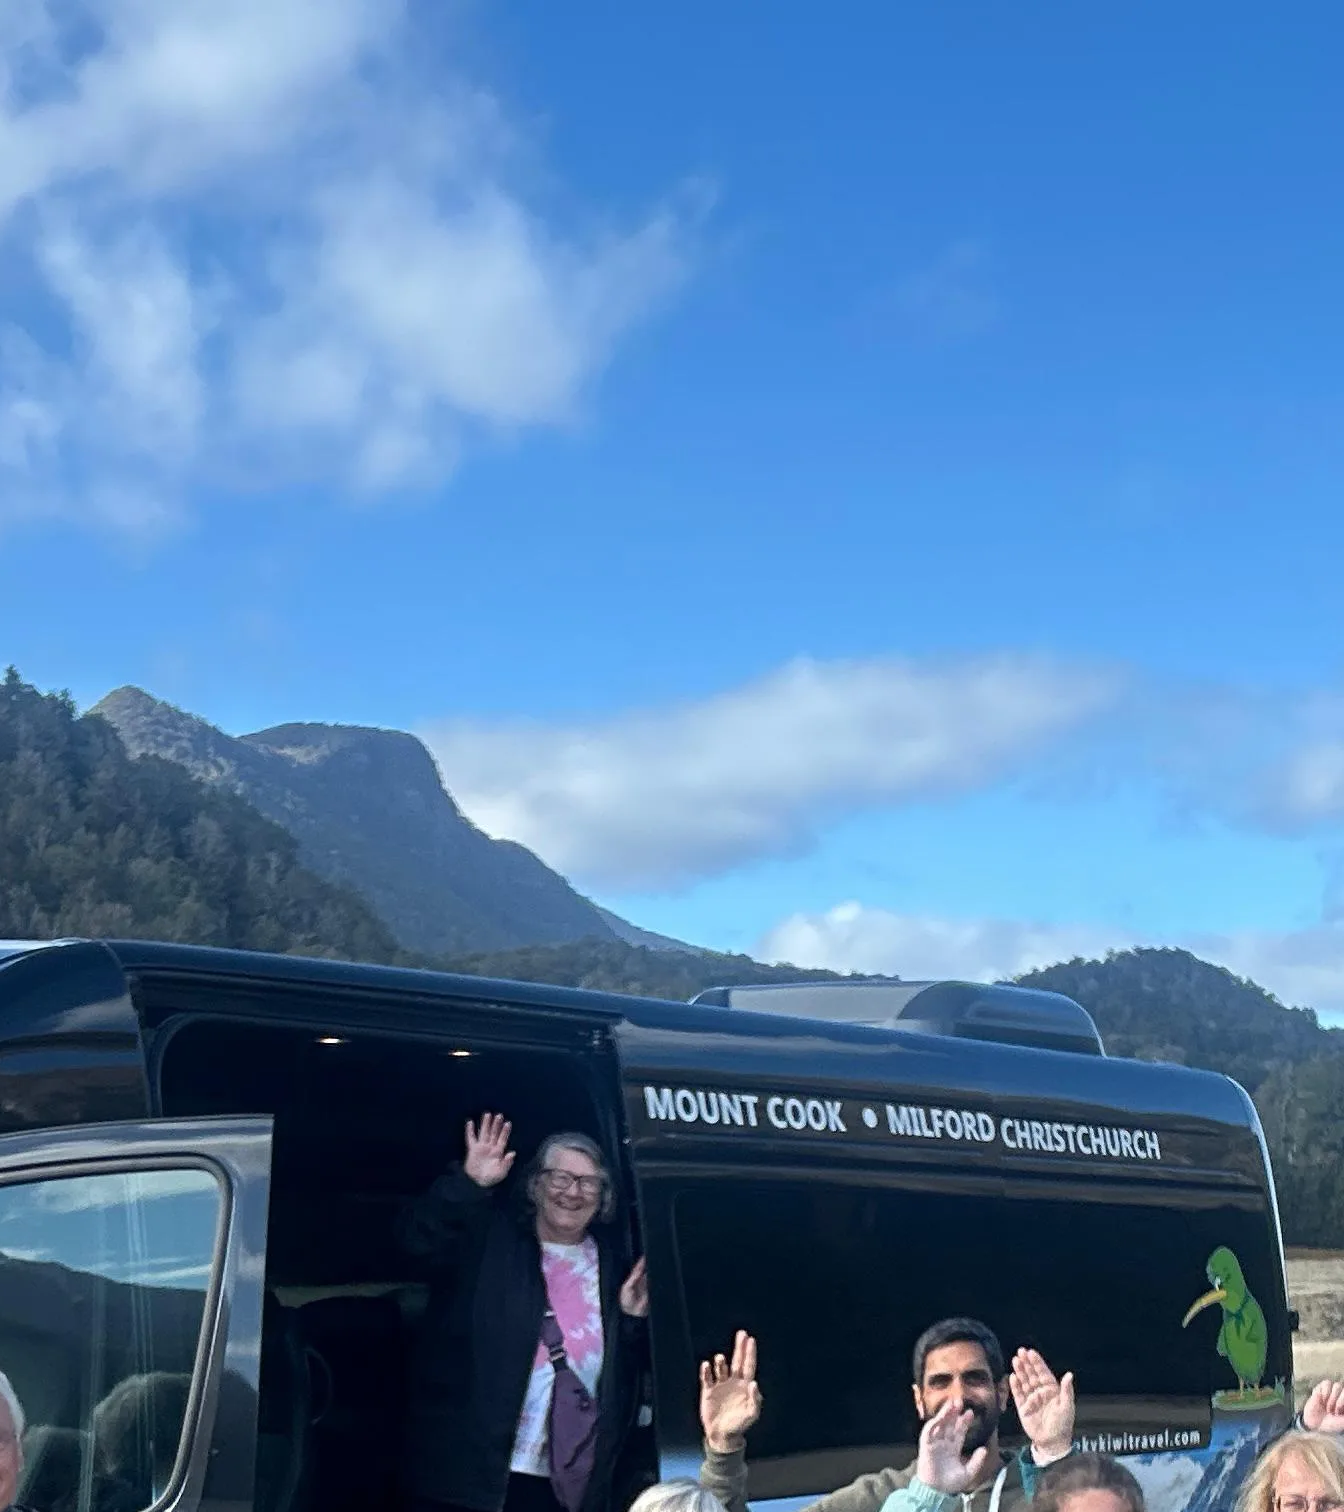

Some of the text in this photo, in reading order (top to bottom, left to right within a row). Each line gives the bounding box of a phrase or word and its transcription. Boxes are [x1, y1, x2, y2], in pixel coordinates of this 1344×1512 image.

[643, 1086, 1162, 1160] MOUNT COOK MILFORD CHRISTCHURCH
